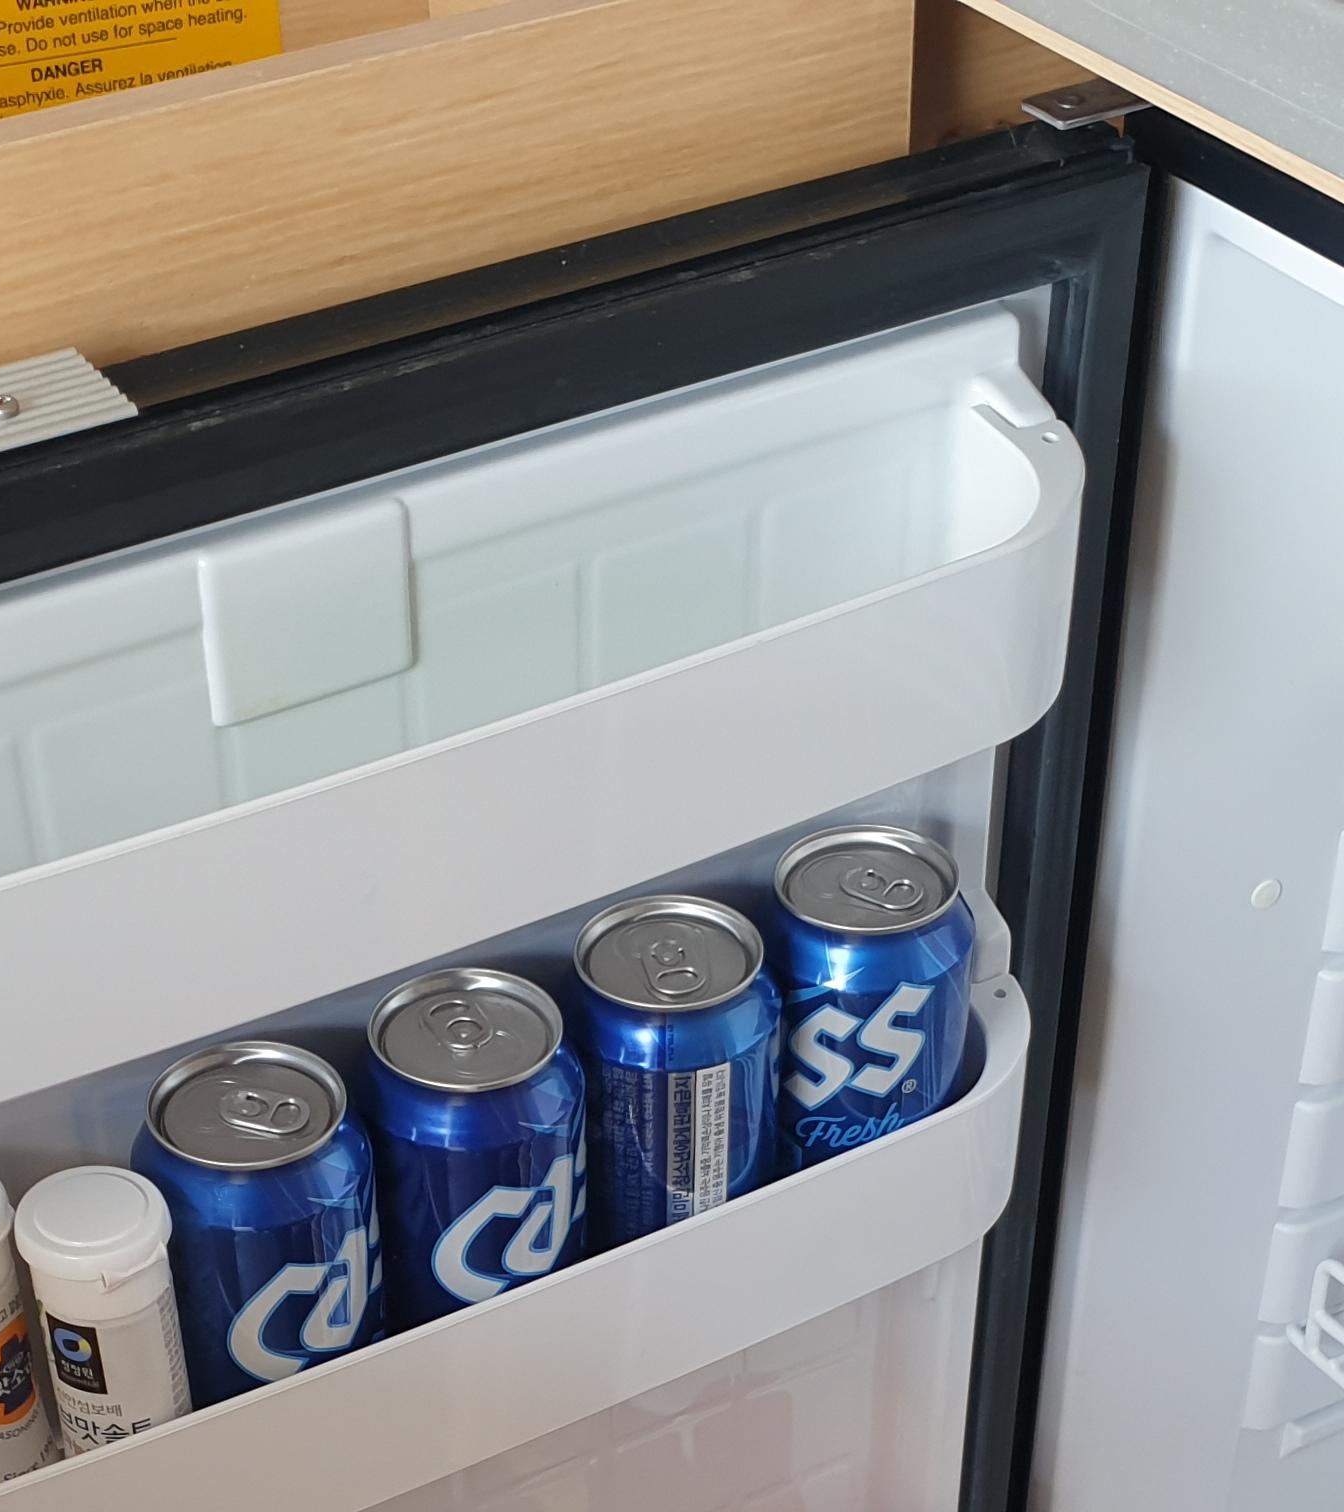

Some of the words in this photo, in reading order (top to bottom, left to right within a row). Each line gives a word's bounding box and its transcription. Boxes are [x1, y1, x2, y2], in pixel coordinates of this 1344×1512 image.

[26, 36, 48, 53] Do
[52, 33, 76, 49] not
[82, 29, 109, 45] use
[113, 24, 133, 39] for
[139, 17, 183, 37] space
[187, 7, 247, 28] heating.
[58, 3, 137, 26] ventilation
[30, 58, 104, 83] DANGER
[75, 76, 136, 97] Assurez
[139, 71, 153, 86] la
[672, 1076, 692, 1126] 판매금지
[795, 1102, 905, 1148] Fresh
